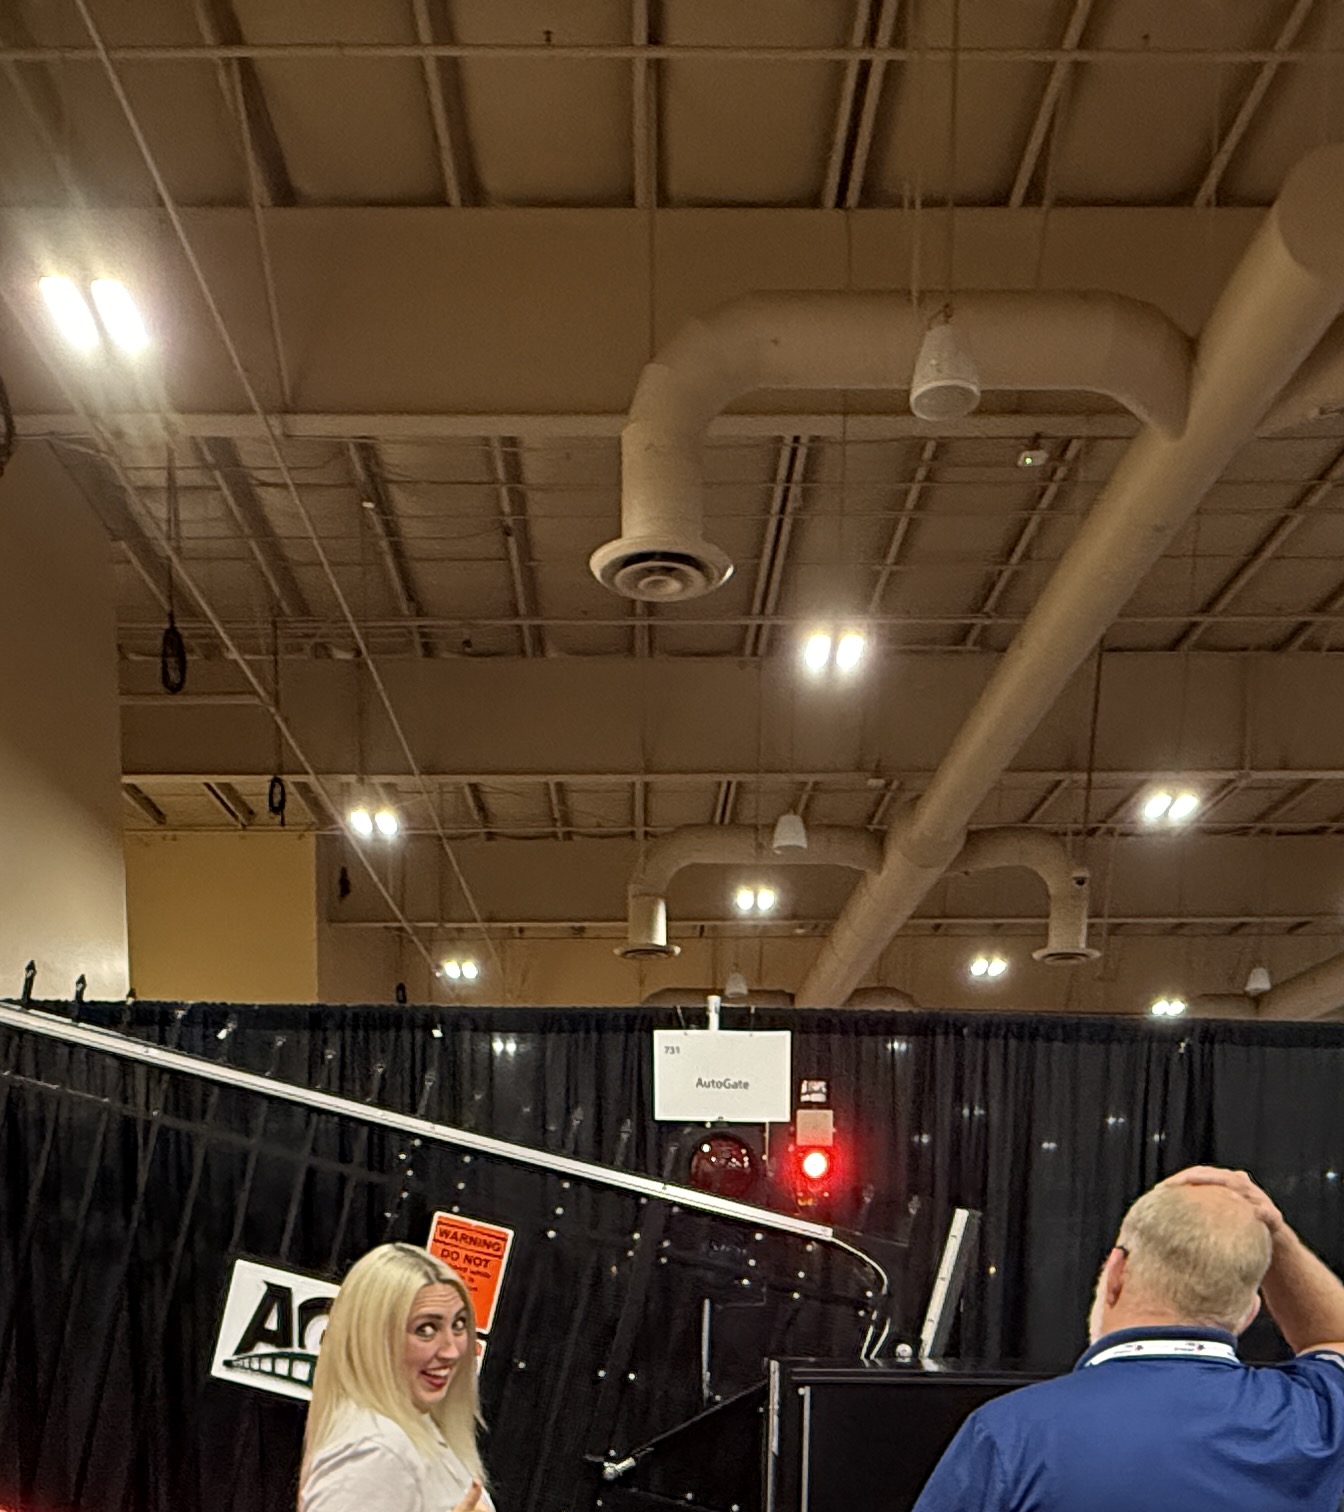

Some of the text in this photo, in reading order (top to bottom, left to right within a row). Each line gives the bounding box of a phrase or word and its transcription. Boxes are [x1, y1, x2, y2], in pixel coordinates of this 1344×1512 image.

[664, 1046, 681, 1055] 731
[695, 1077, 750, 1090] AutoGate
[438, 1228, 502, 1252] WARNING
[440, 1248, 460, 1261] DO
[463, 1254, 491, 1268] NOT
